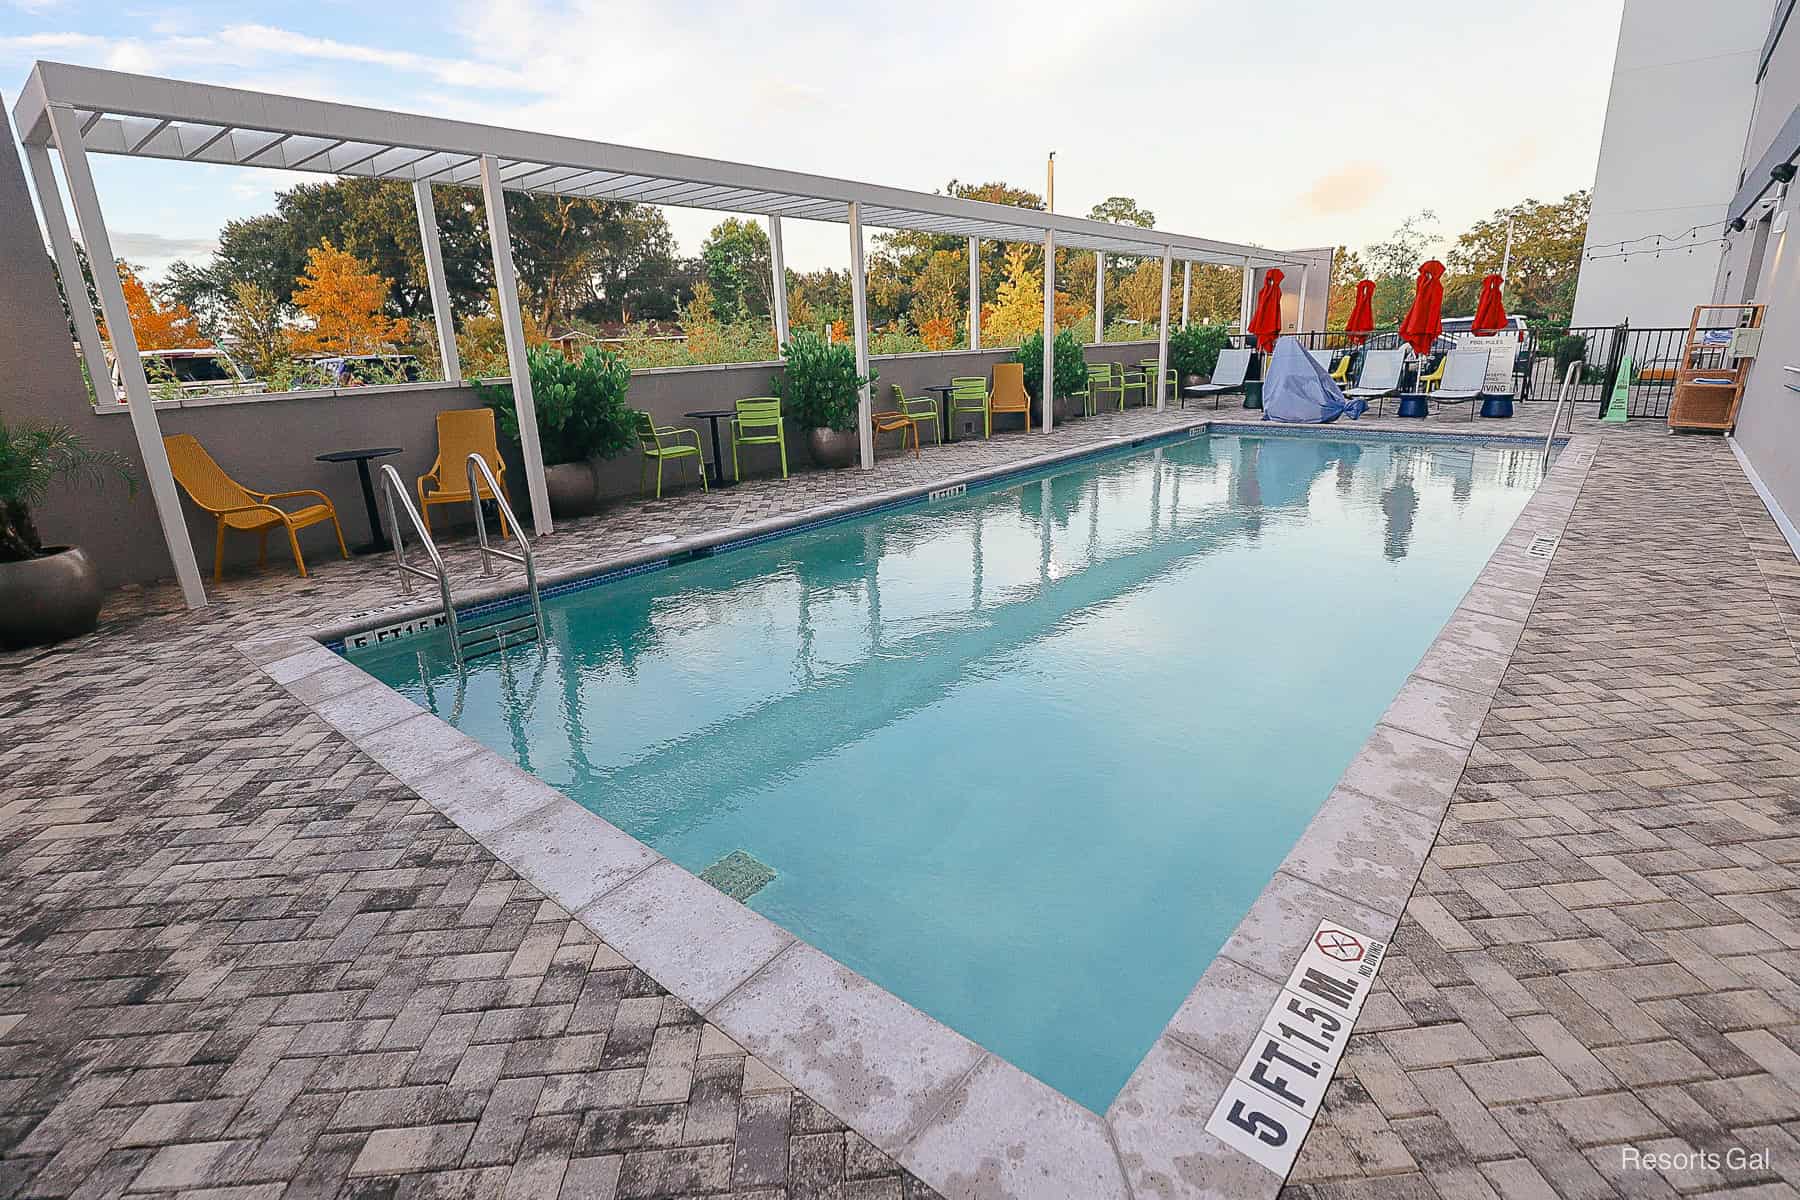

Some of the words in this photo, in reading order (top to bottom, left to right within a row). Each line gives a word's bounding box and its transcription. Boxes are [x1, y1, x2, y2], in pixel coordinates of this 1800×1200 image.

[1363, 942, 1384, 967] DIVING
[1358, 965, 1374, 978] NO
[1226, 1099, 1289, 1148] 5
